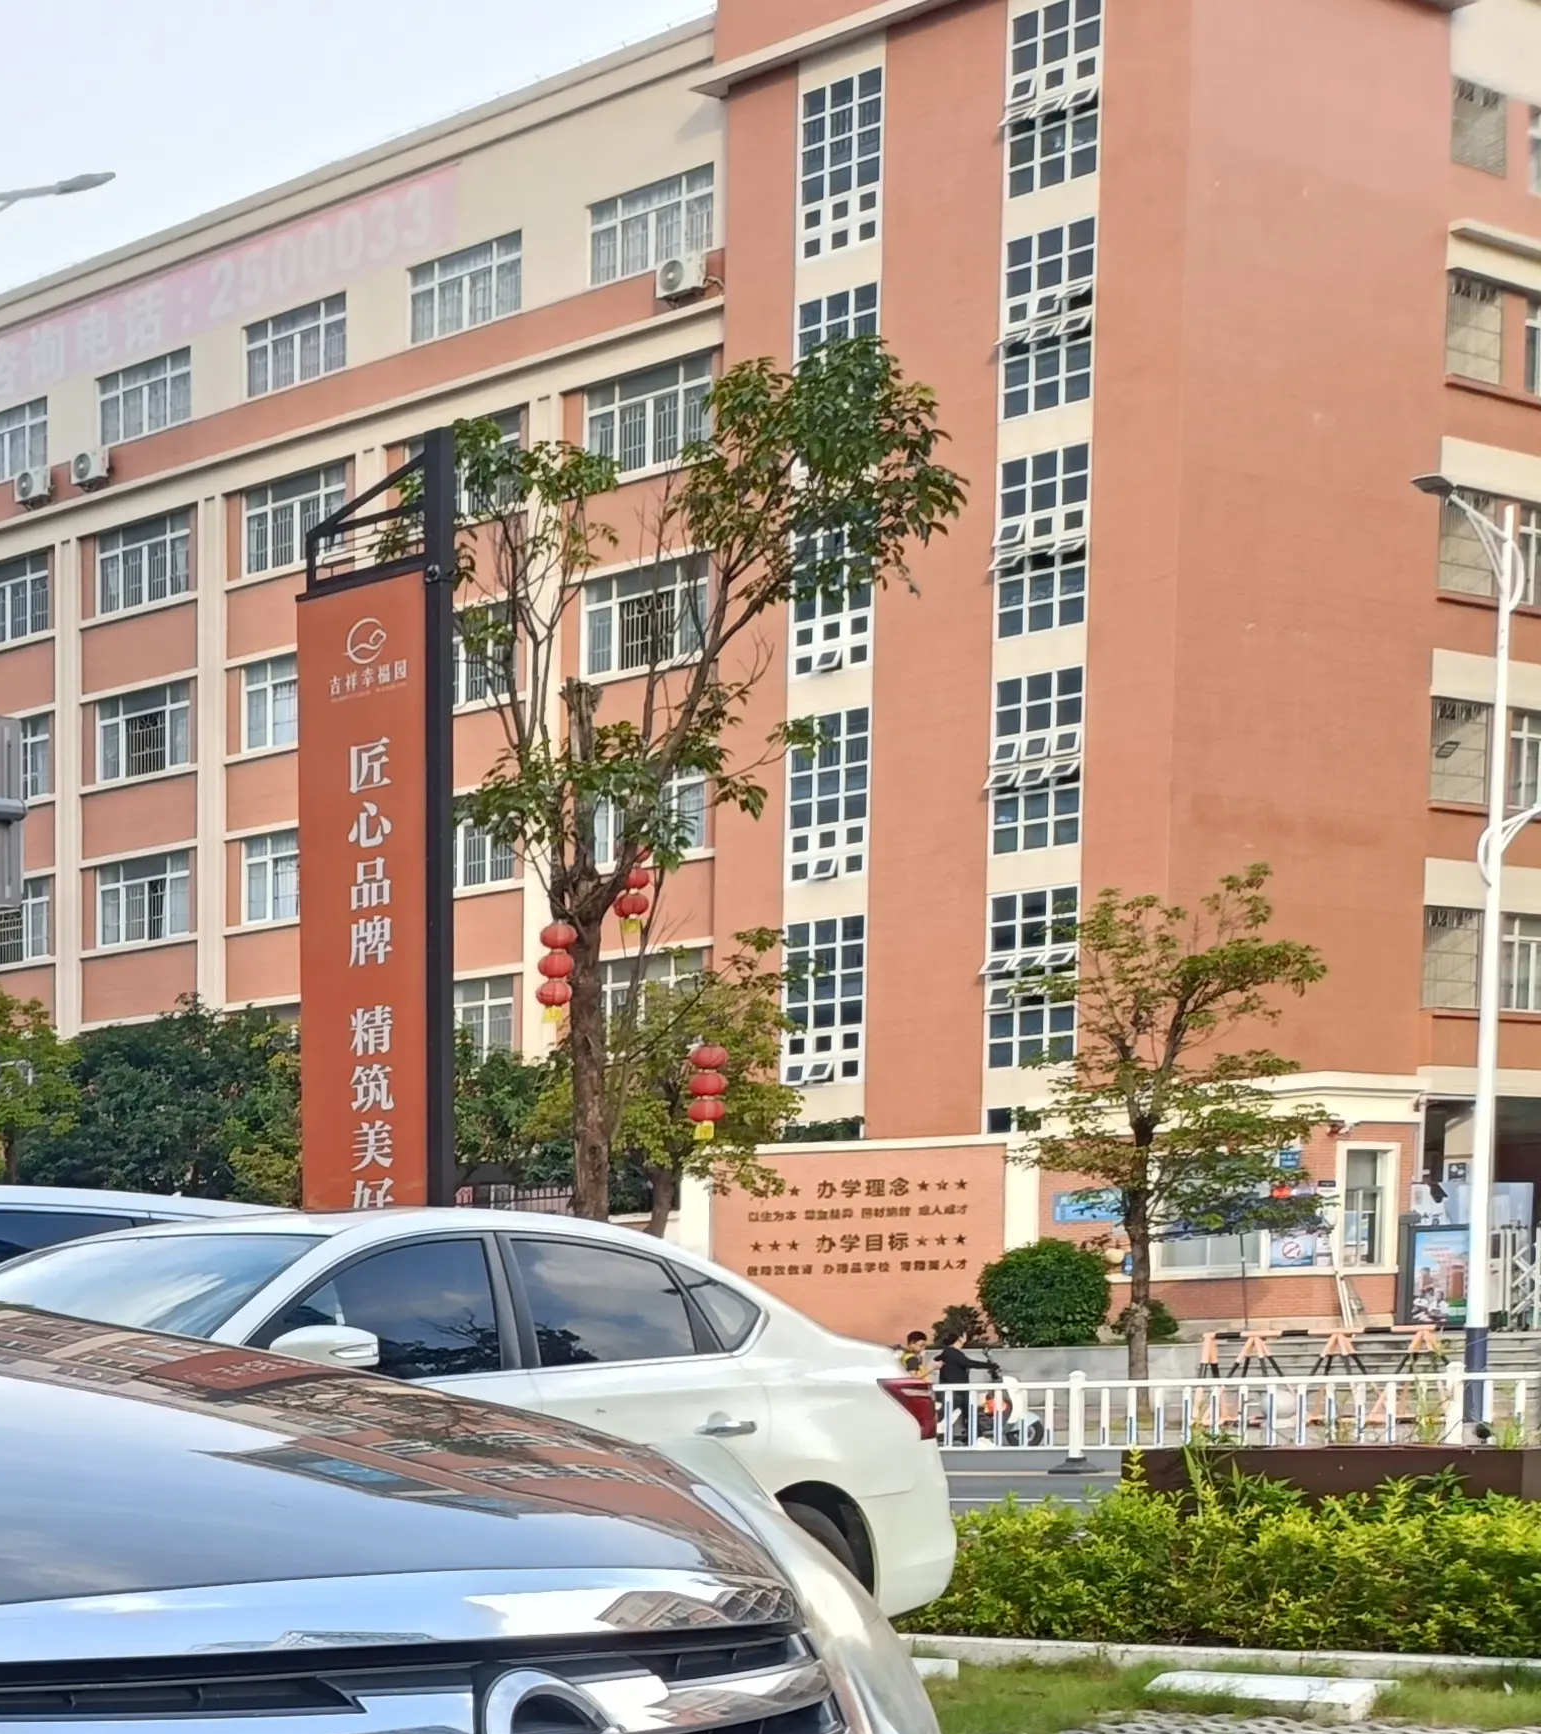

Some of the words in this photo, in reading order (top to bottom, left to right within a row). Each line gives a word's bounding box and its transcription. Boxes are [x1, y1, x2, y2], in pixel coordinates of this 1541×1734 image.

[329, 658, 407, 697] 吉祥幸福园
[348, 736, 393, 968] 匠心品牌
[349, 1005, 395, 1209] 精筑美好
[817, 1177, 910, 1199] 办学理念
[816, 1232, 909, 1253] 办学目标
